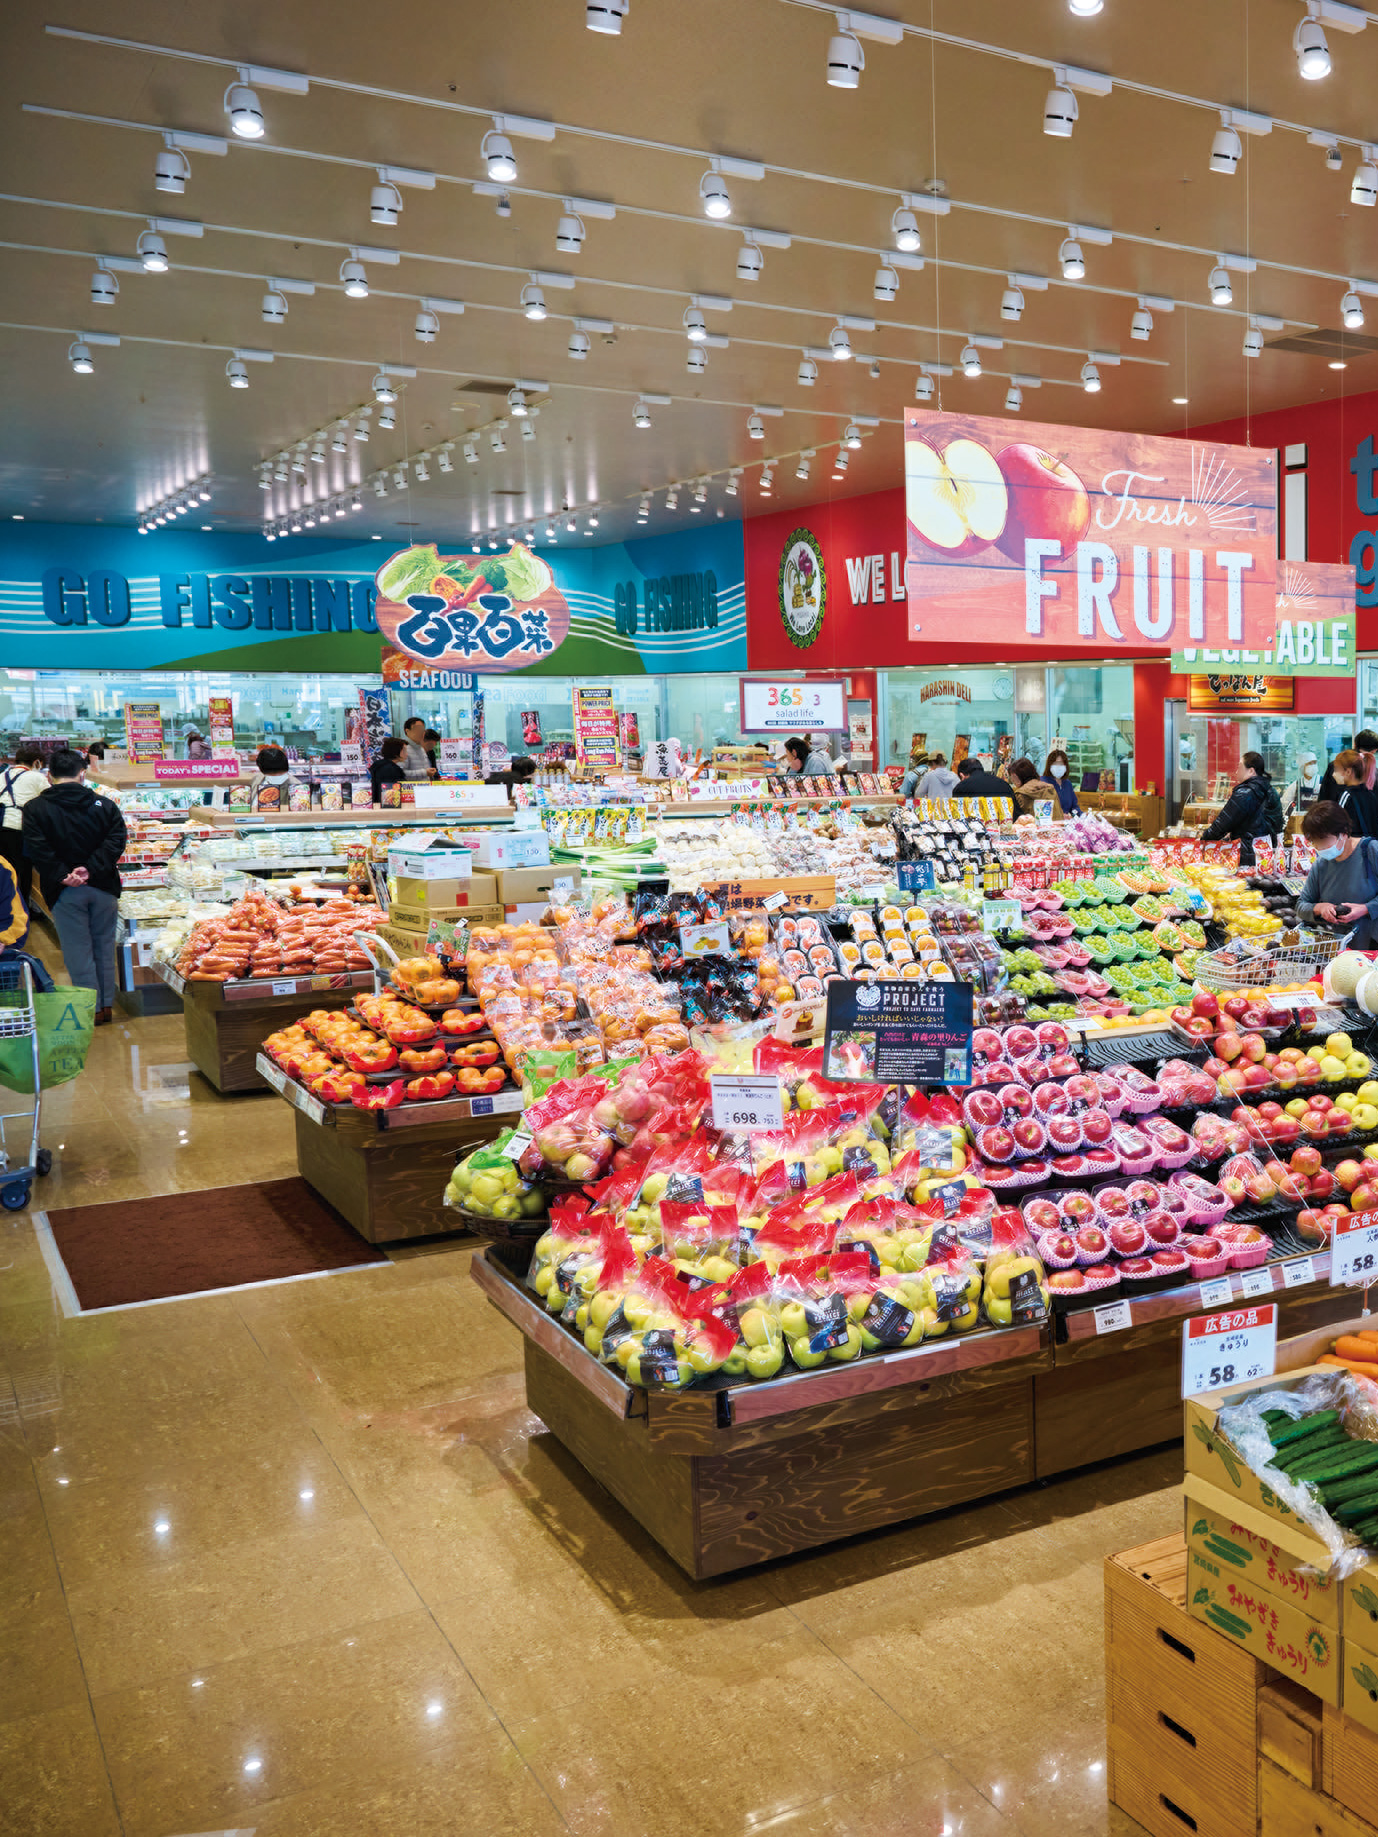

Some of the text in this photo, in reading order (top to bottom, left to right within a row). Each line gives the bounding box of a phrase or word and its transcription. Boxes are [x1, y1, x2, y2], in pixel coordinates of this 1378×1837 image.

[1096, 469, 1199, 531] Fresh
[845, 551, 908, 606] WE L
[41, 567, 132, 627] GO
[1024, 538, 1253, 642] FRUIT
[614, 569, 719, 636] GO FISHING
[399, 669, 473, 690] SEAFOOD
[767, 687, 803, 706] 365
[920, 680, 972, 704] HARASHIN DELI
[776, 708, 814, 718] salad life
[192, 765, 237, 774] SPECIAL
[449, 790, 466, 799] 365
[708, 785, 752, 795] CUT FRUITS
[883, 993, 946, 1006] PROJECT
[51, 1002, 87, 1032] A
[48, 1057, 84, 1073] TEA
[733, 1112, 757, 1125] 698
[1352, 1253, 1374, 1273] 58
[1204, 1309, 1258, 1333] 広告の品
[1219, 1338, 1249, 1352] きゅうり
[1208, 1364, 1235, 1386] 58
[1247, 1368, 1258, 1377] 62
[1266, 1556, 1310, 1600] きゅうり
[1266, 1630, 1308, 1675] きゅうり
